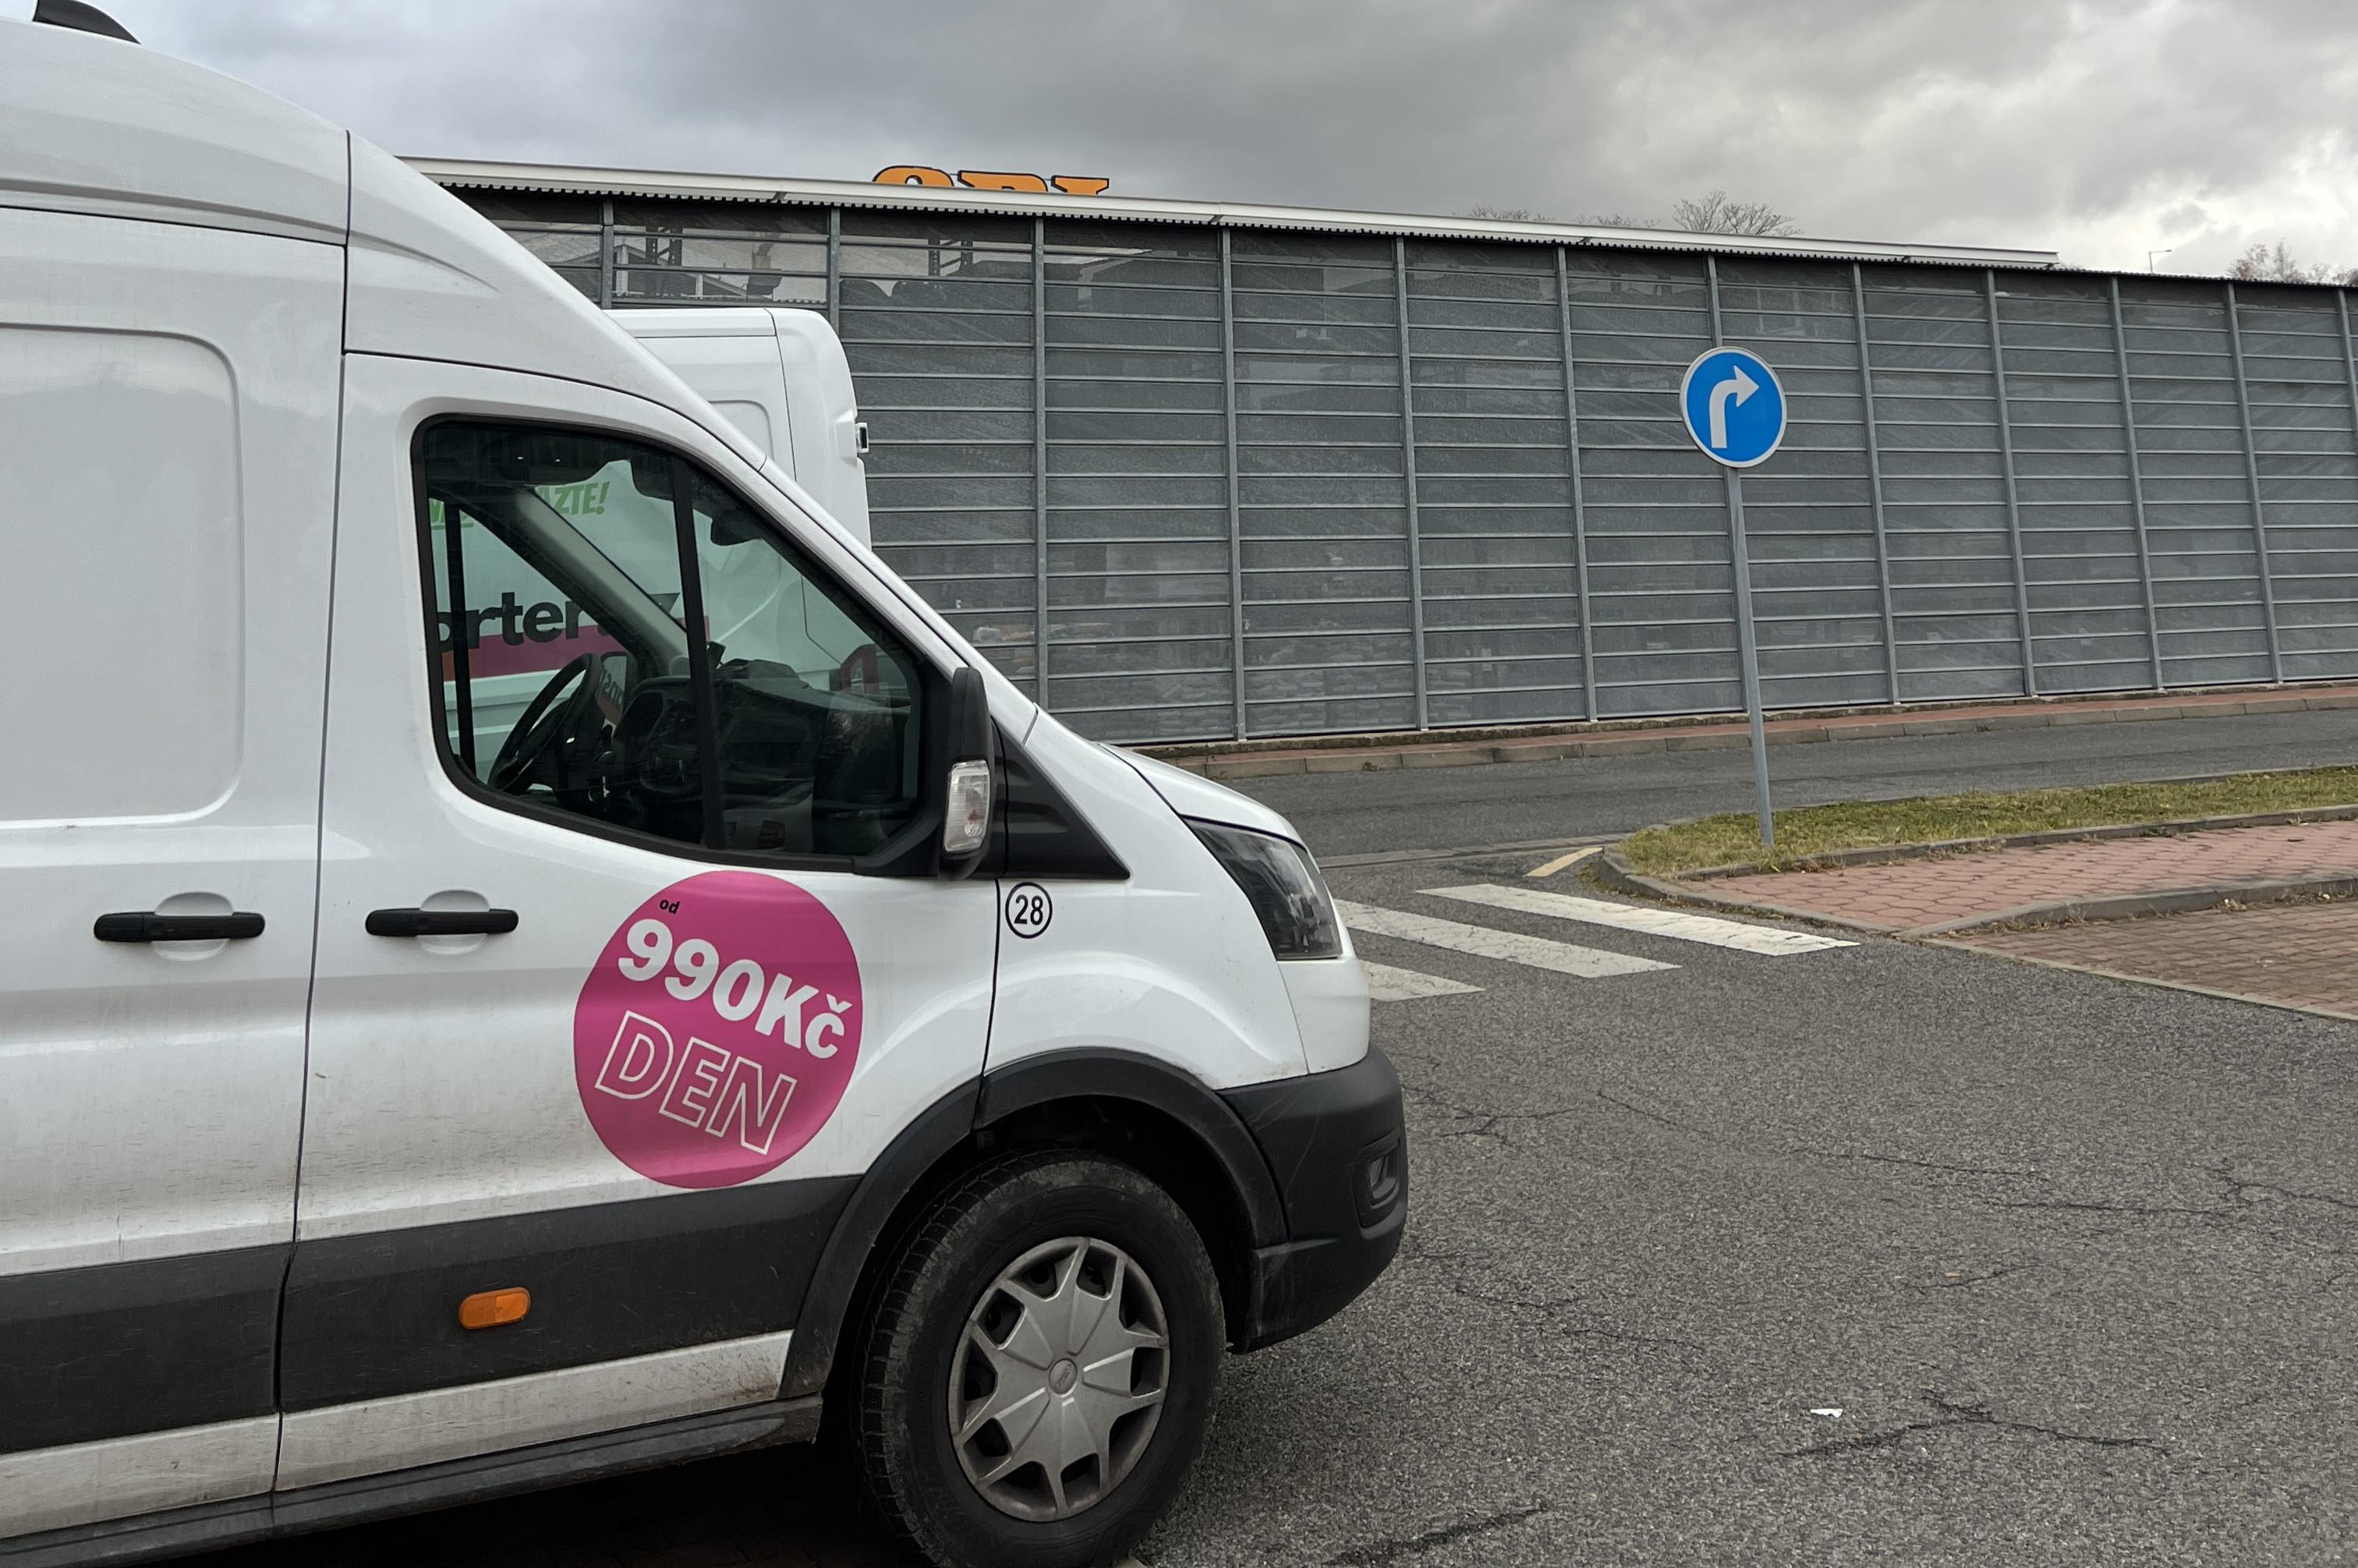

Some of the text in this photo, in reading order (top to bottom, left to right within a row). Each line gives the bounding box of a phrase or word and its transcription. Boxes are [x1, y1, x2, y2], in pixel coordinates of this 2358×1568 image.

[659, 898, 680, 915] od
[1014, 895, 1044, 926] 28
[595, 1011, 797, 1156] DEN
